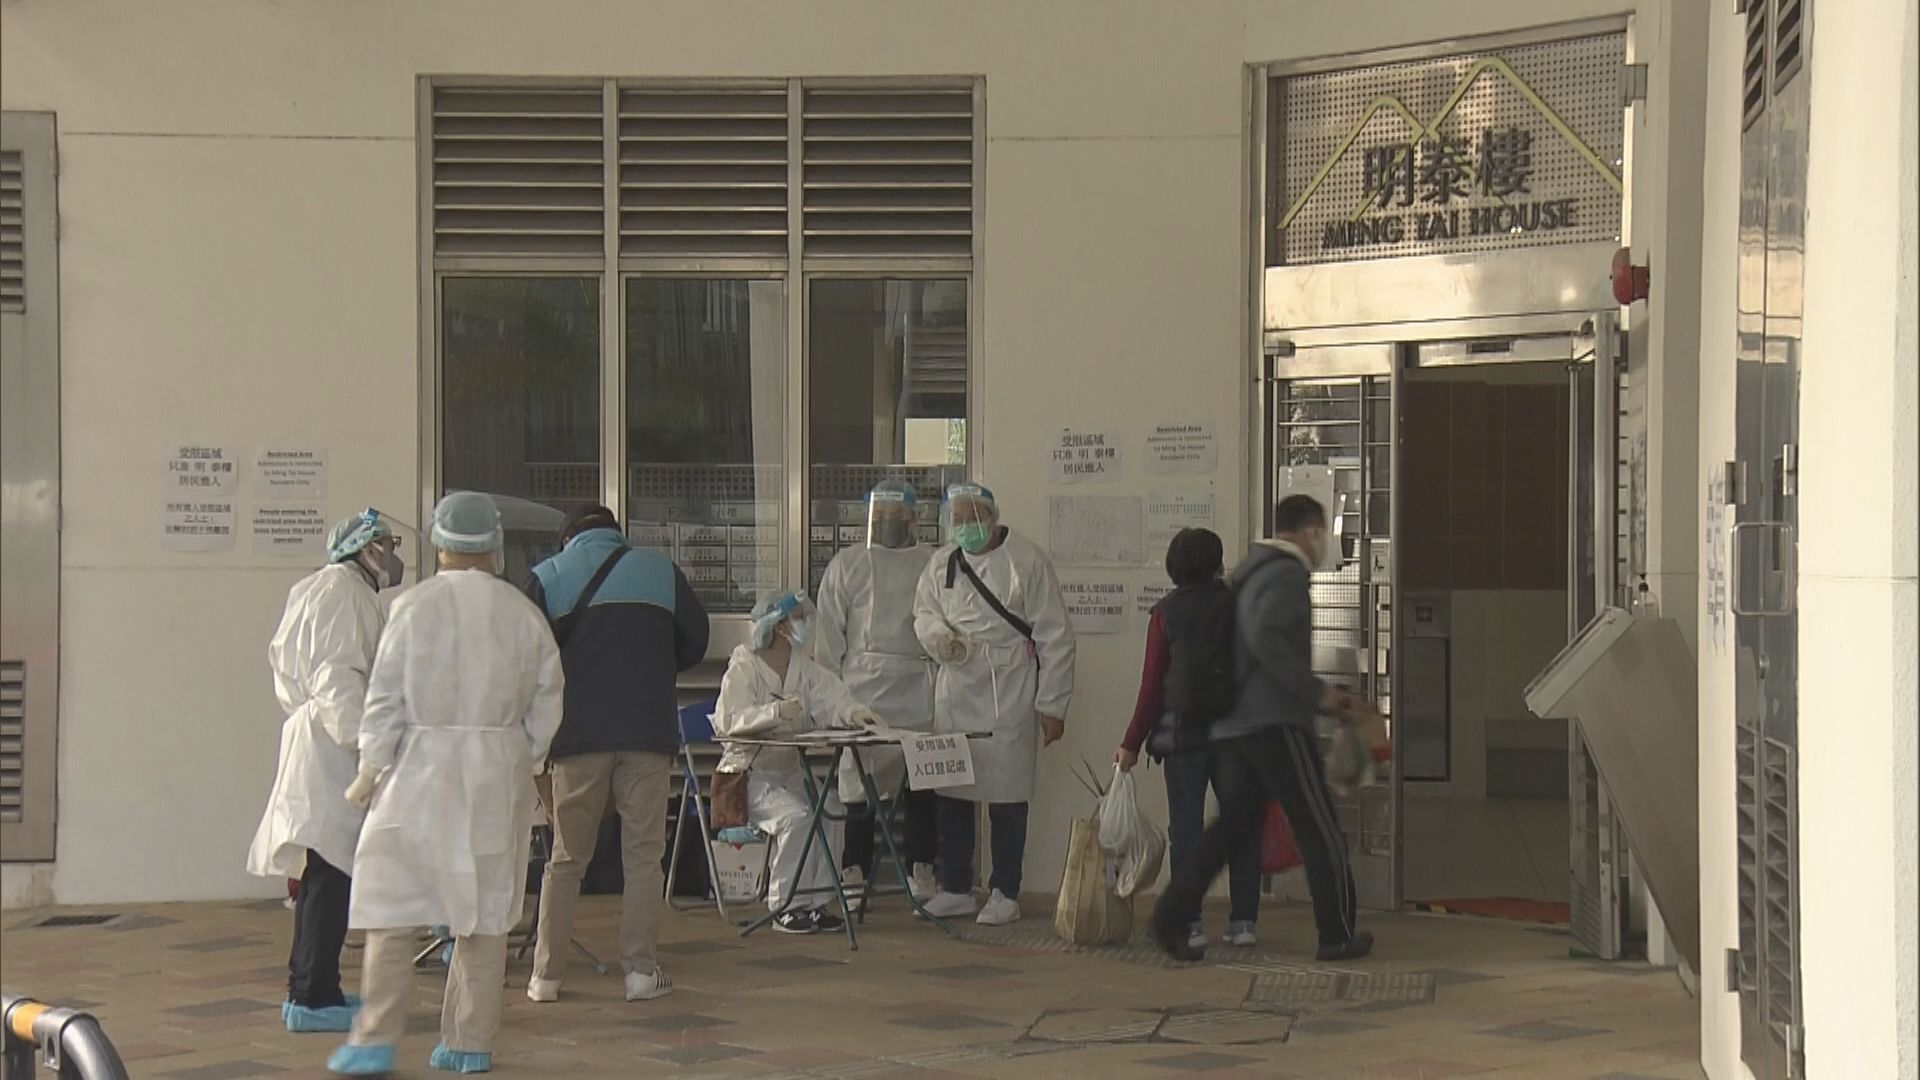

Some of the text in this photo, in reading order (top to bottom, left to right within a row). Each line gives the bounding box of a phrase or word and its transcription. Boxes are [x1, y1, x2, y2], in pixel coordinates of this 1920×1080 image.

[1363, 127, 1534, 208] 明泰樓
[1322, 198, 1580, 248] MING TAI HOUSE
[1143, 585, 1164, 593] People
[915, 737, 956, 753] 受限區域
